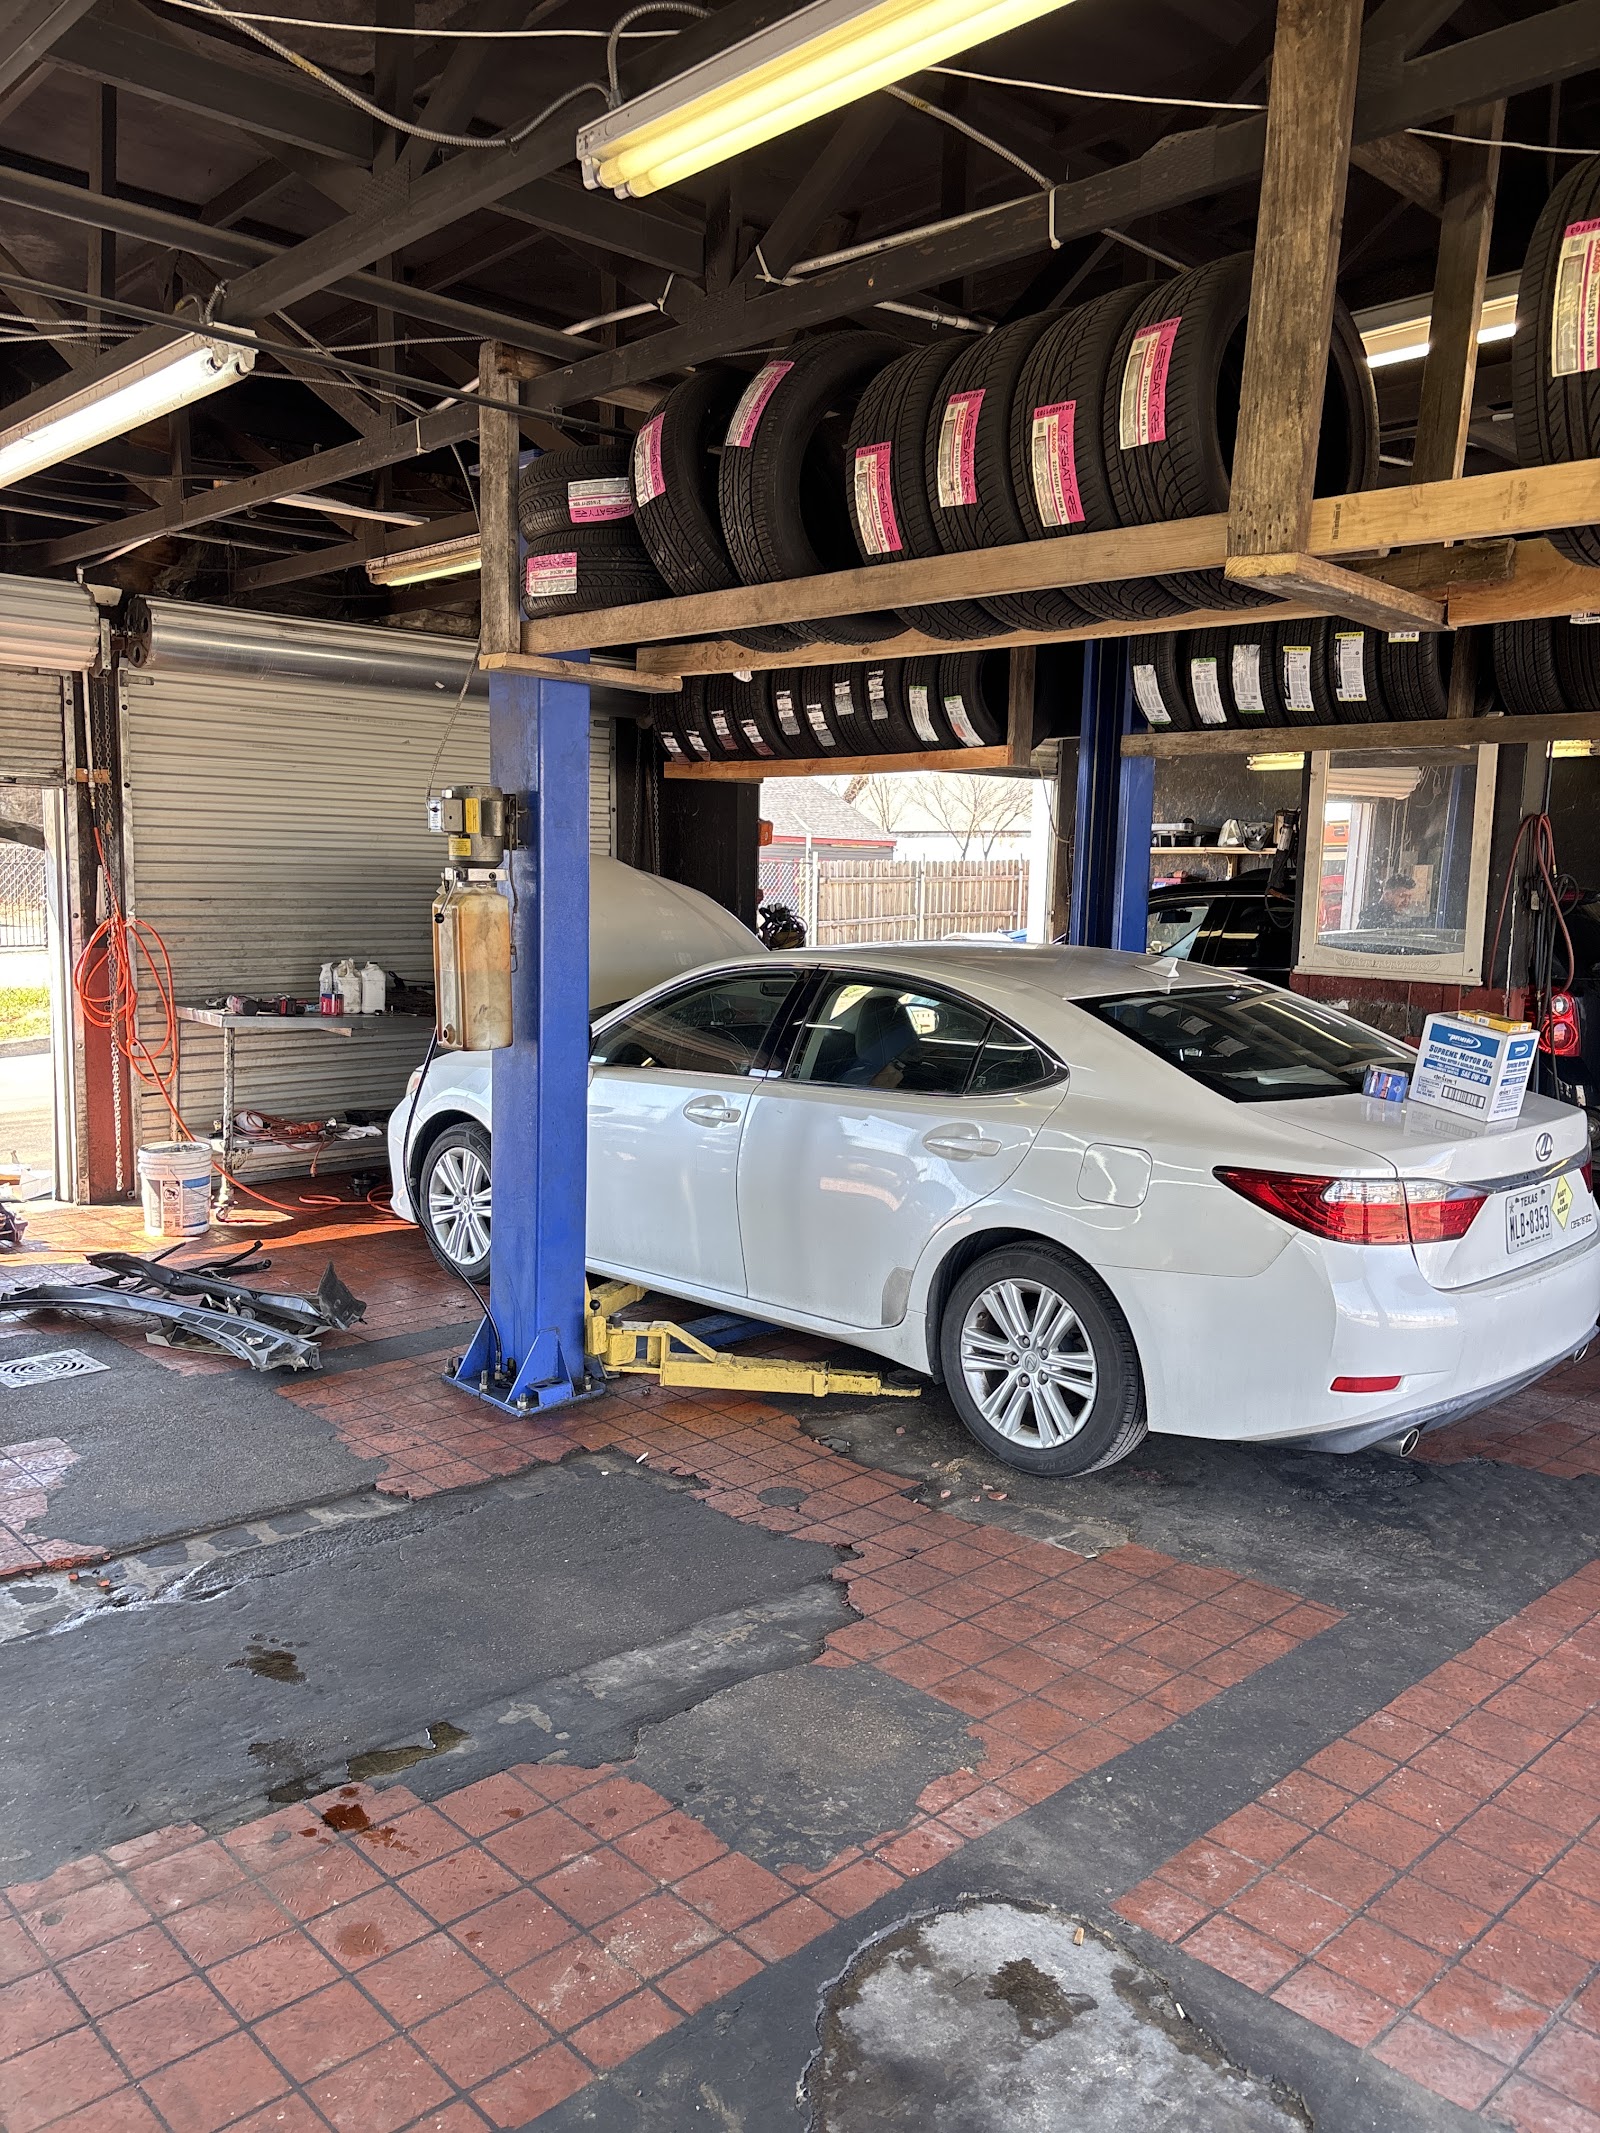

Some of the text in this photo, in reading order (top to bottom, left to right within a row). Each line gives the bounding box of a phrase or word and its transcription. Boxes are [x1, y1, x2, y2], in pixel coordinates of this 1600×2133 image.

[1150, 338, 1170, 434] VERSATYRE
[1060, 423, 1079, 515] VERSATYRE
[1520, 1193, 1538, 1208] TEXAS
